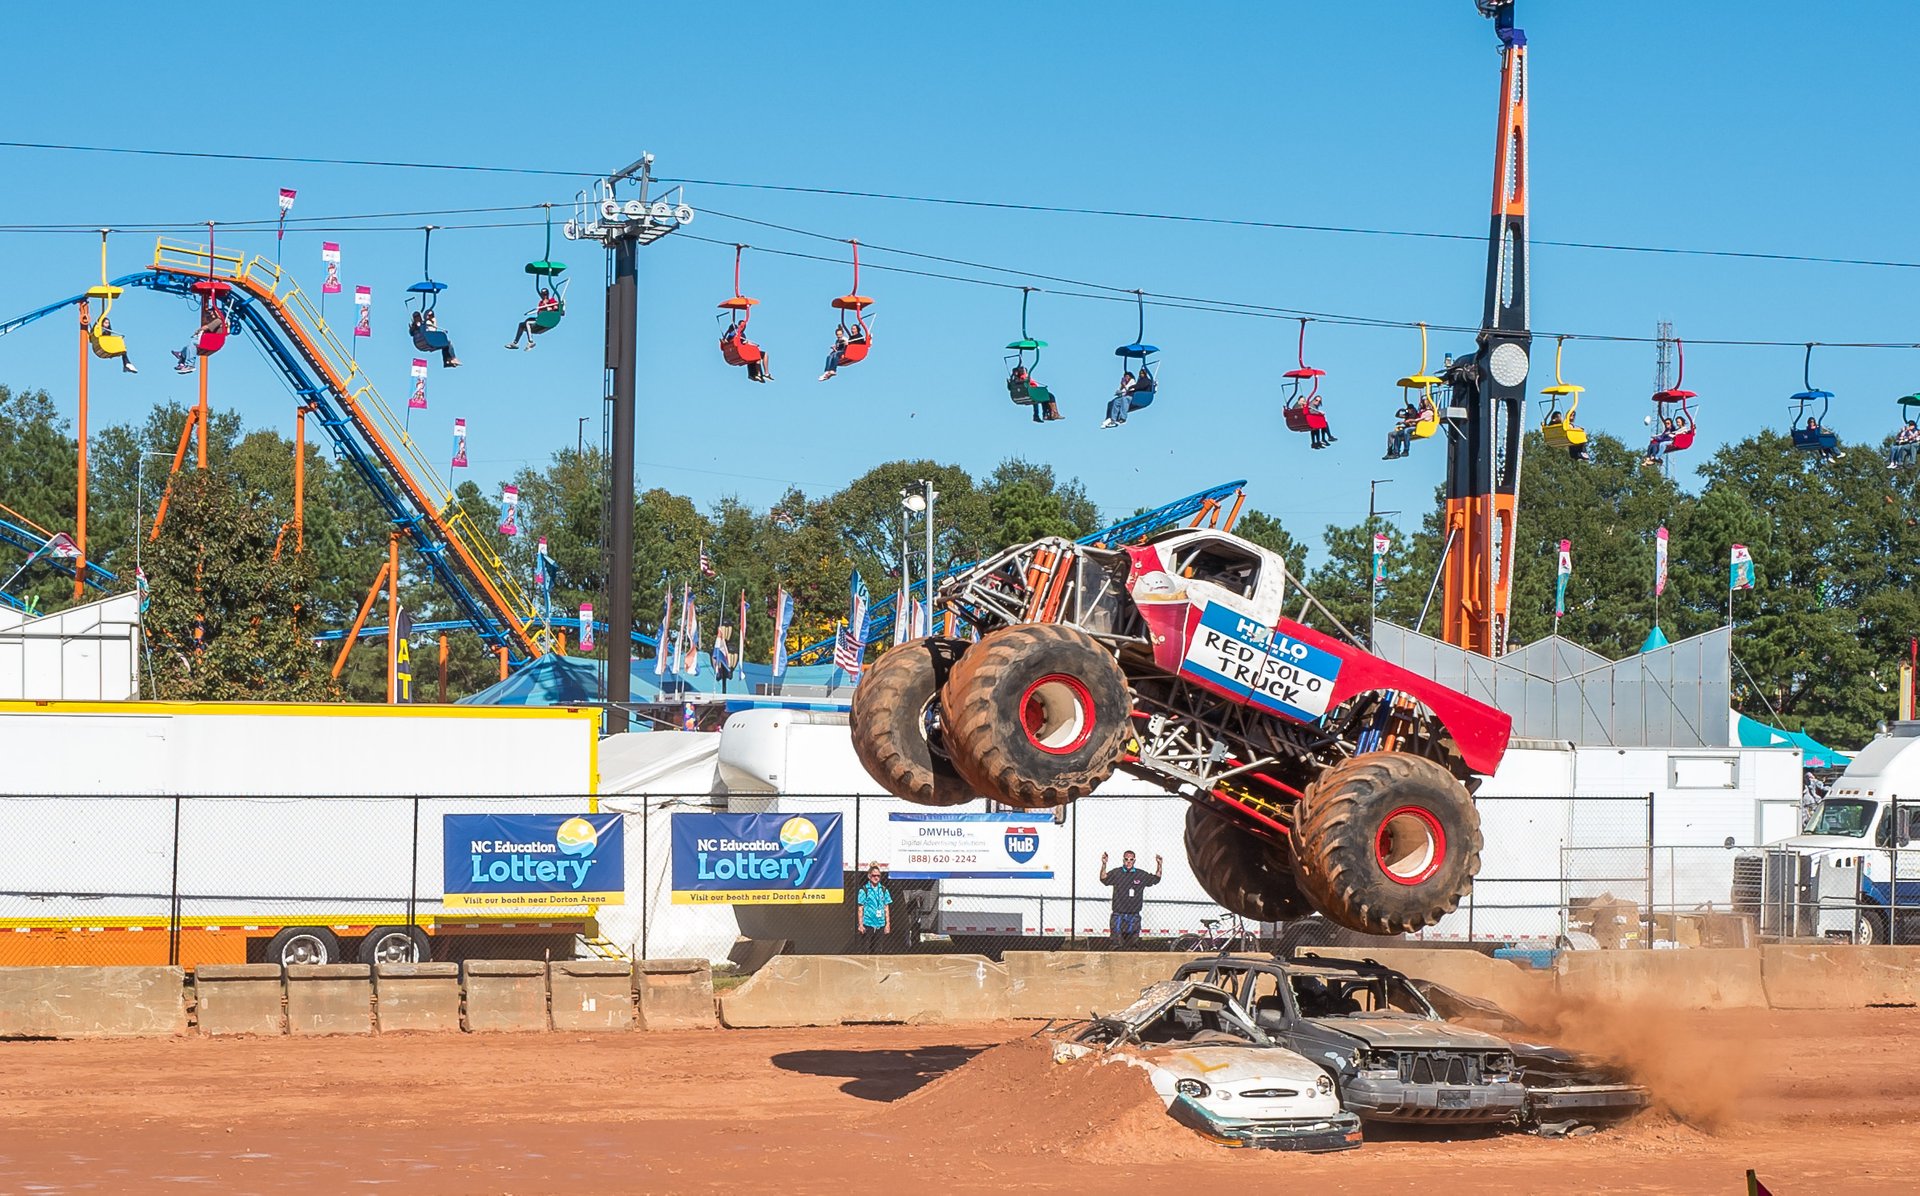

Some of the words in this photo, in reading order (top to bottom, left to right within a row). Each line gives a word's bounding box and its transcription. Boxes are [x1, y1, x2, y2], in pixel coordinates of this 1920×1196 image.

[1205, 631, 1254, 662] RED
[1265, 659, 1322, 693] SOLO
[1218, 656, 1299, 704] TRUCK
[471, 841, 492, 853] NC
[495, 841, 556, 853] Education
[697, 839, 717, 852] NC
[720, 839, 780, 852] Education
[901, 839, 922, 847] Digital
[923, 839, 957, 848] Advertising
[958, 839, 986, 847] Solutions
[908, 855, 931, 864] (888)
[933, 855, 950, 863] 620
[471, 854, 592, 889] Lottery
[698, 852, 813, 887] Lottery
[463, 896, 482, 904] Visit
[501, 895, 525, 904] booth
[550, 896, 578, 904] Dorton
[581, 895, 606, 903] Arena
[690, 893, 708, 901] Visit
[726, 893, 750, 901] booth
[801, 892, 826, 900] Arena
